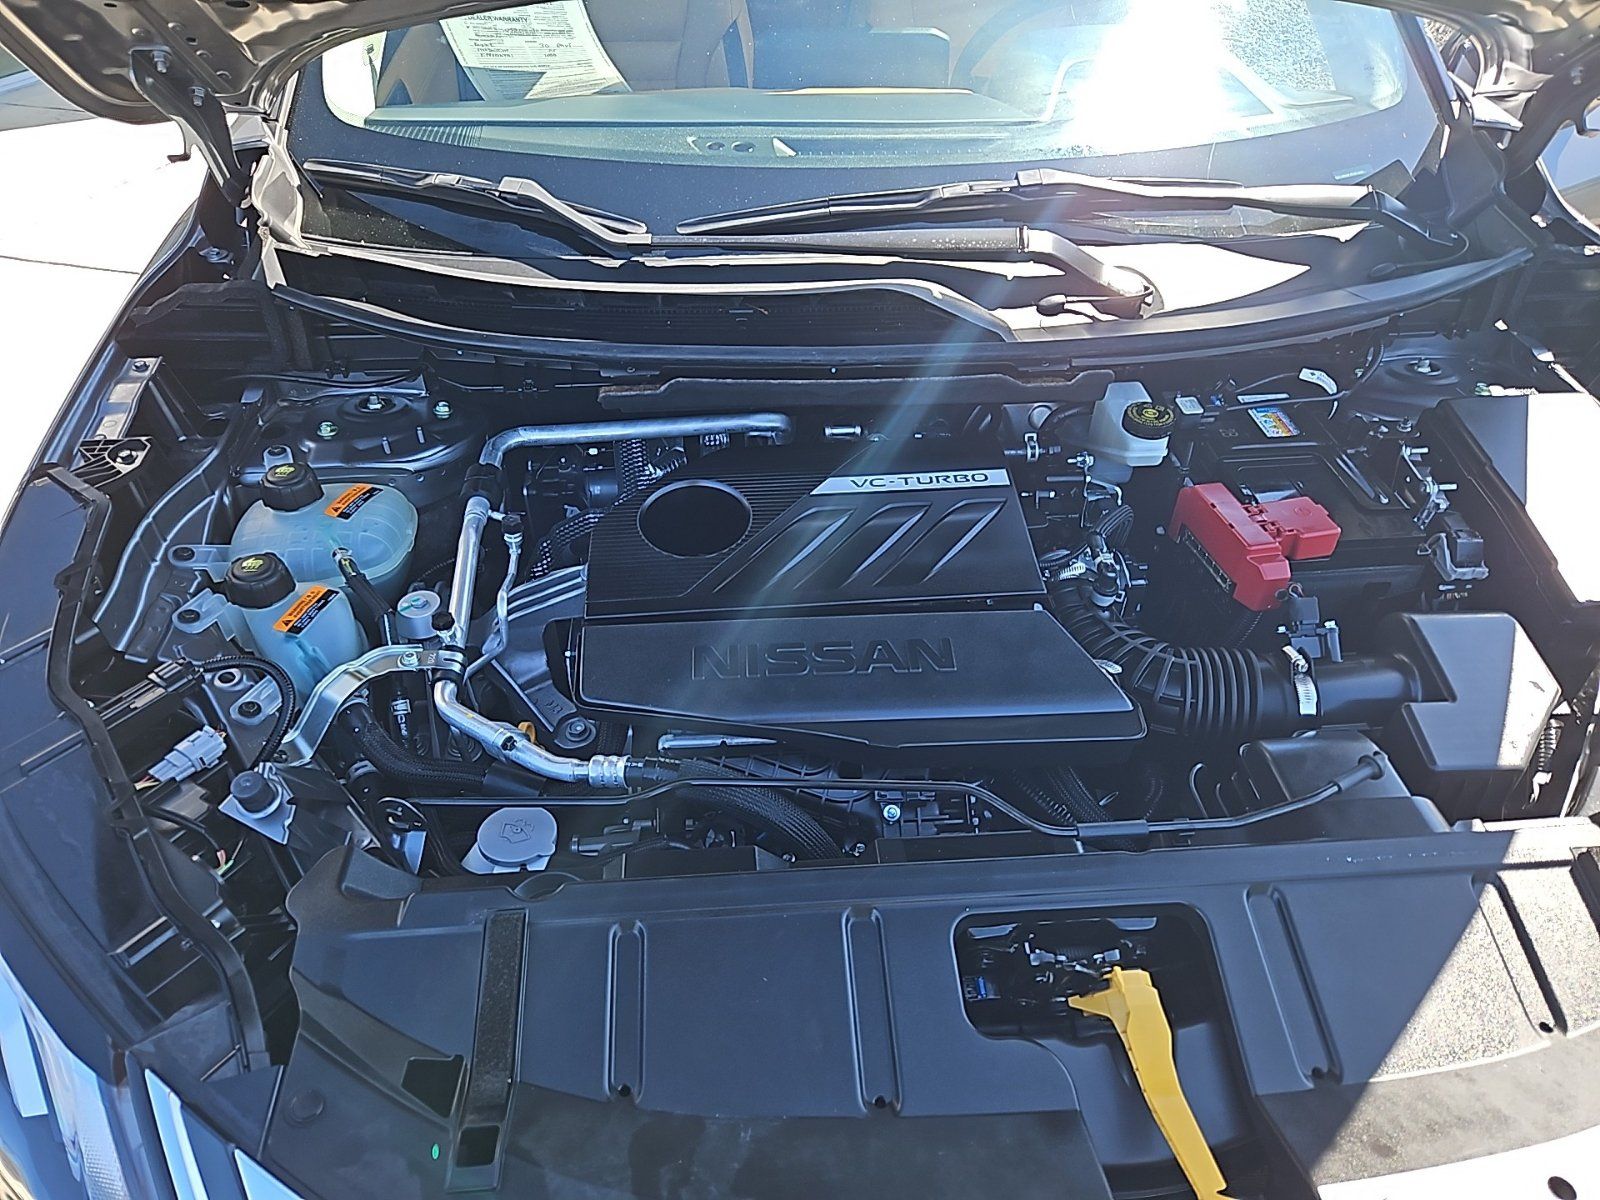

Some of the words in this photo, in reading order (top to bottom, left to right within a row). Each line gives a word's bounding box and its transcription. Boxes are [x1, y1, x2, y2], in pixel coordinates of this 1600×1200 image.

[494, 15, 528, 23] WARRANTY
[850, 473, 989, 488] VC-TURBO
[691, 638, 958, 680] NISSAN
